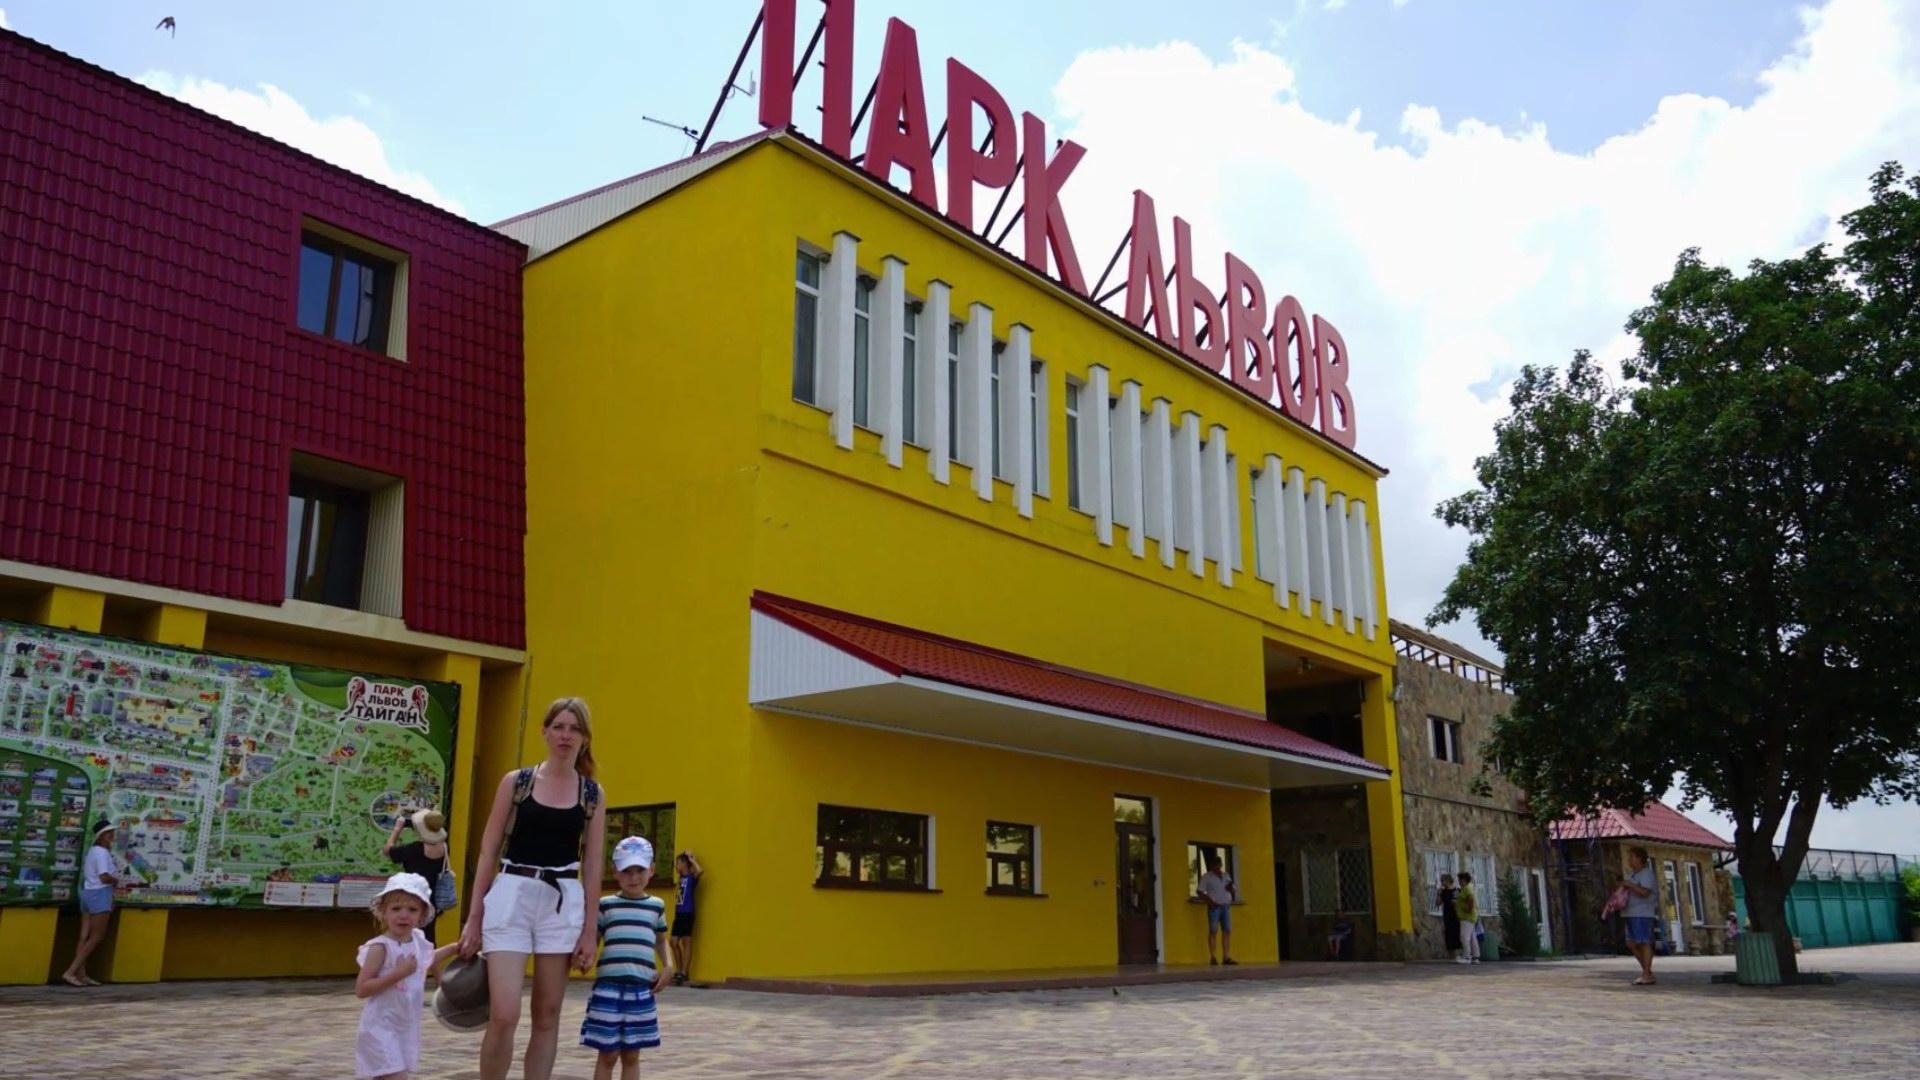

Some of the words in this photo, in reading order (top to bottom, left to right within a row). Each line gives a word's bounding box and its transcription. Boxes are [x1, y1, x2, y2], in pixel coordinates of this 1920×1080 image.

[759, 0, 1090, 299] ПАРК
[1125, 188, 1356, 451] ЛЬВОВ
[373, 684, 405, 697] ПАРК
[368, 694, 408, 708] ЛЬВОВ
[356, 705, 417, 724] ТАЙГАН
